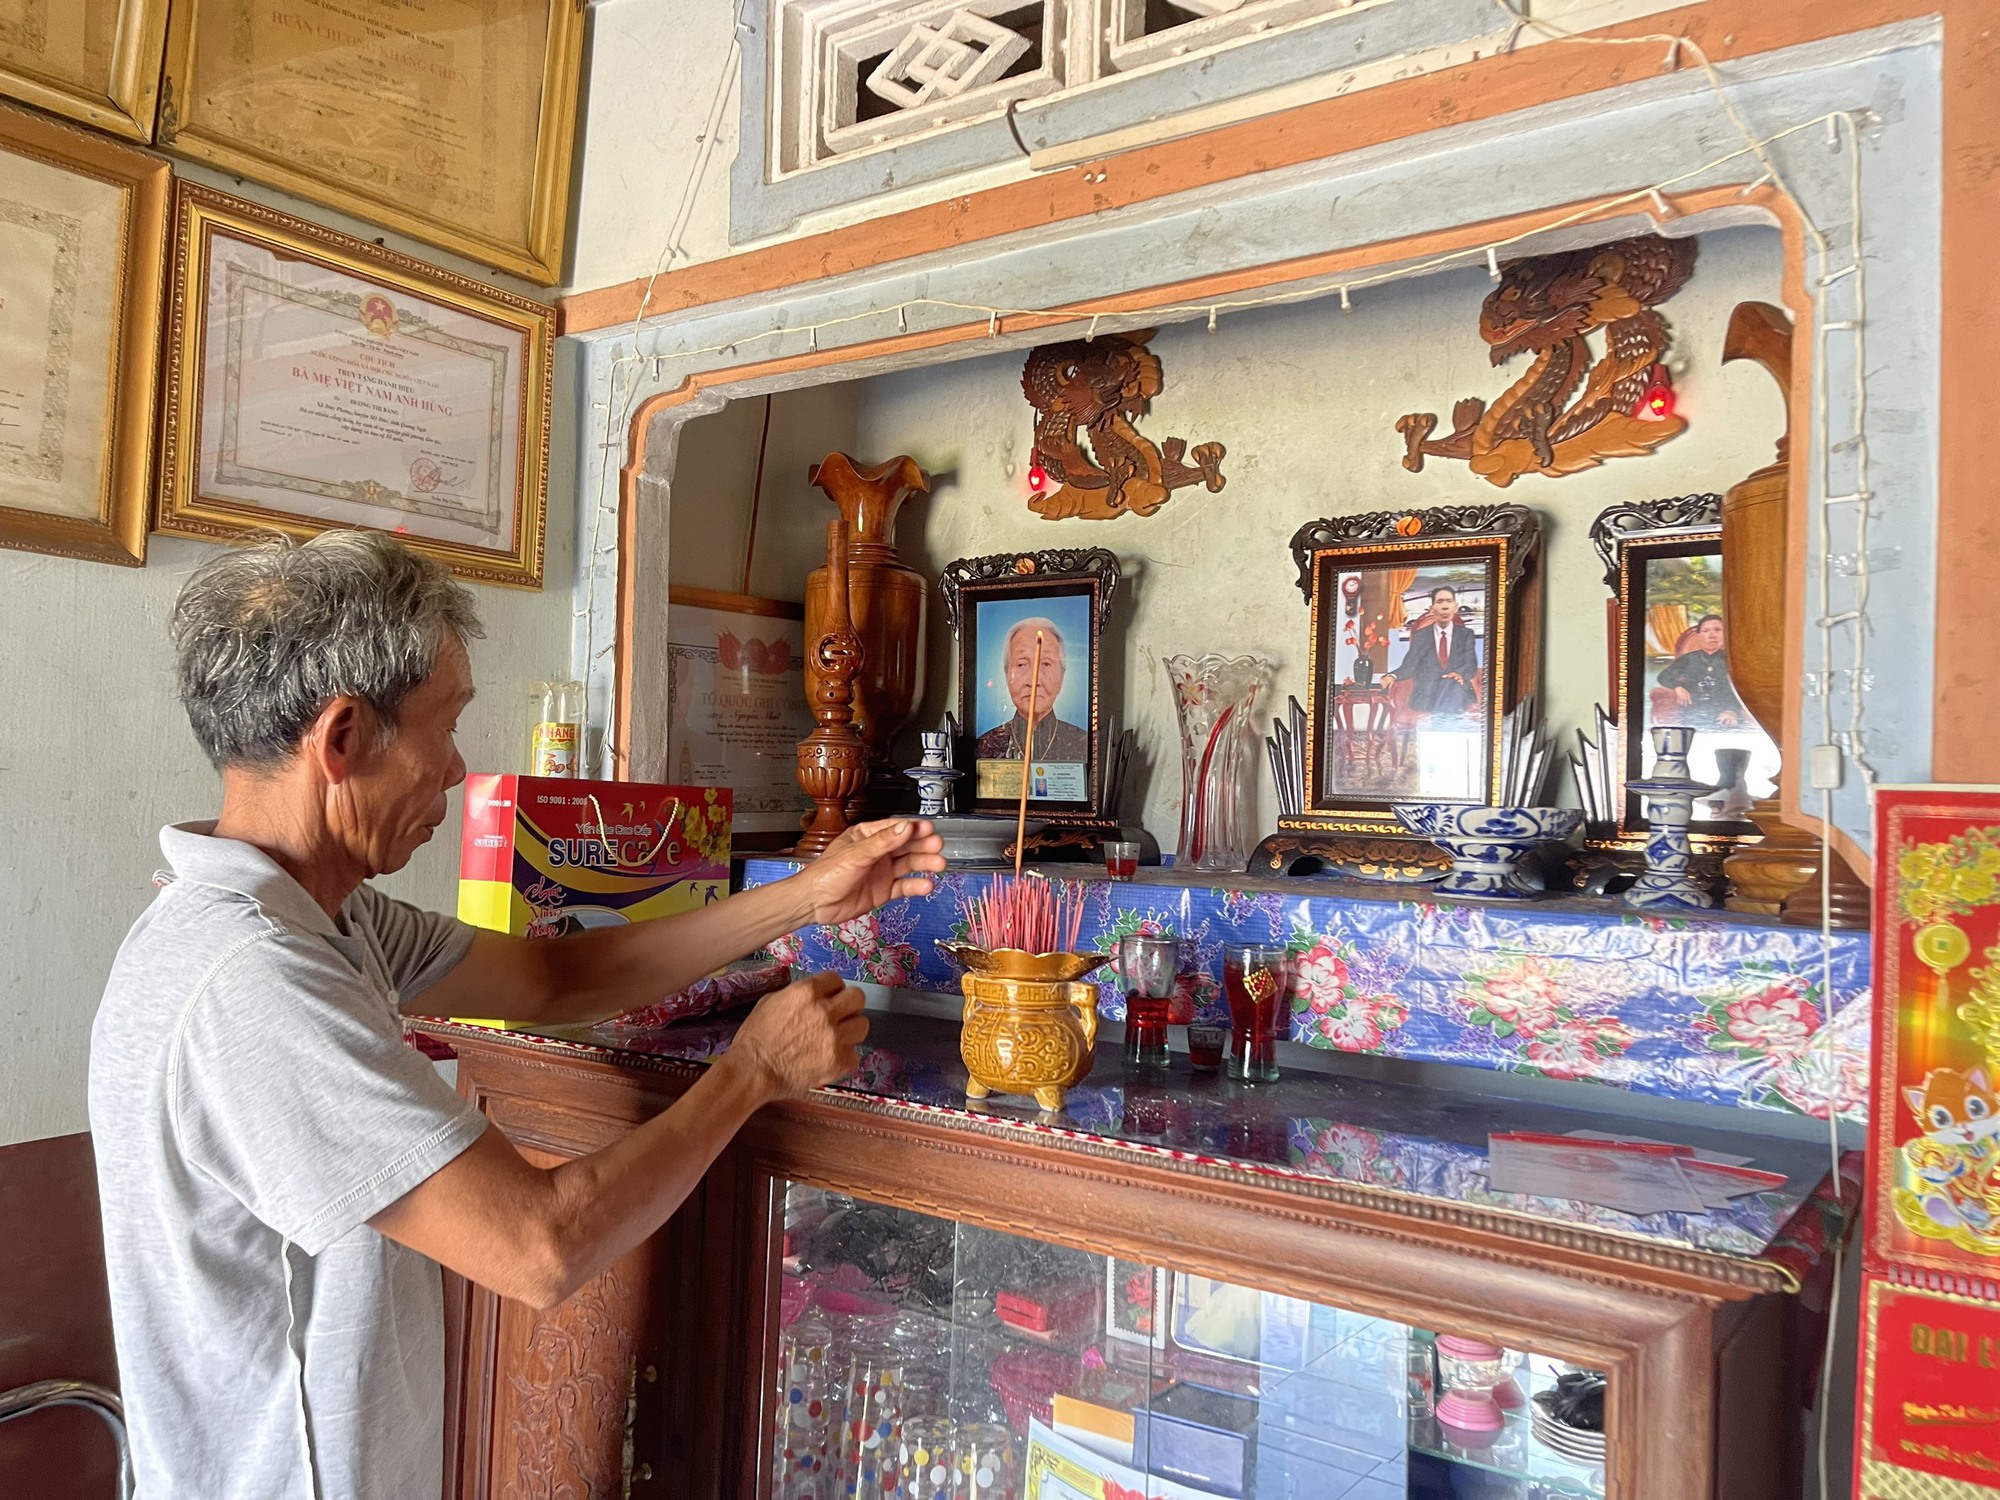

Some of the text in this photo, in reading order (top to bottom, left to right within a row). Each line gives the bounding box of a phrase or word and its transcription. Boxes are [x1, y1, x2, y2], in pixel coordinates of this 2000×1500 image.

[292, 365, 454, 417] BÀ MẸ VIỆT NAM ANH HÙNG
[719, 692, 753, 708] QUỐC
[537, 795, 548, 804] ISO
[549, 796, 566, 805] 9001
